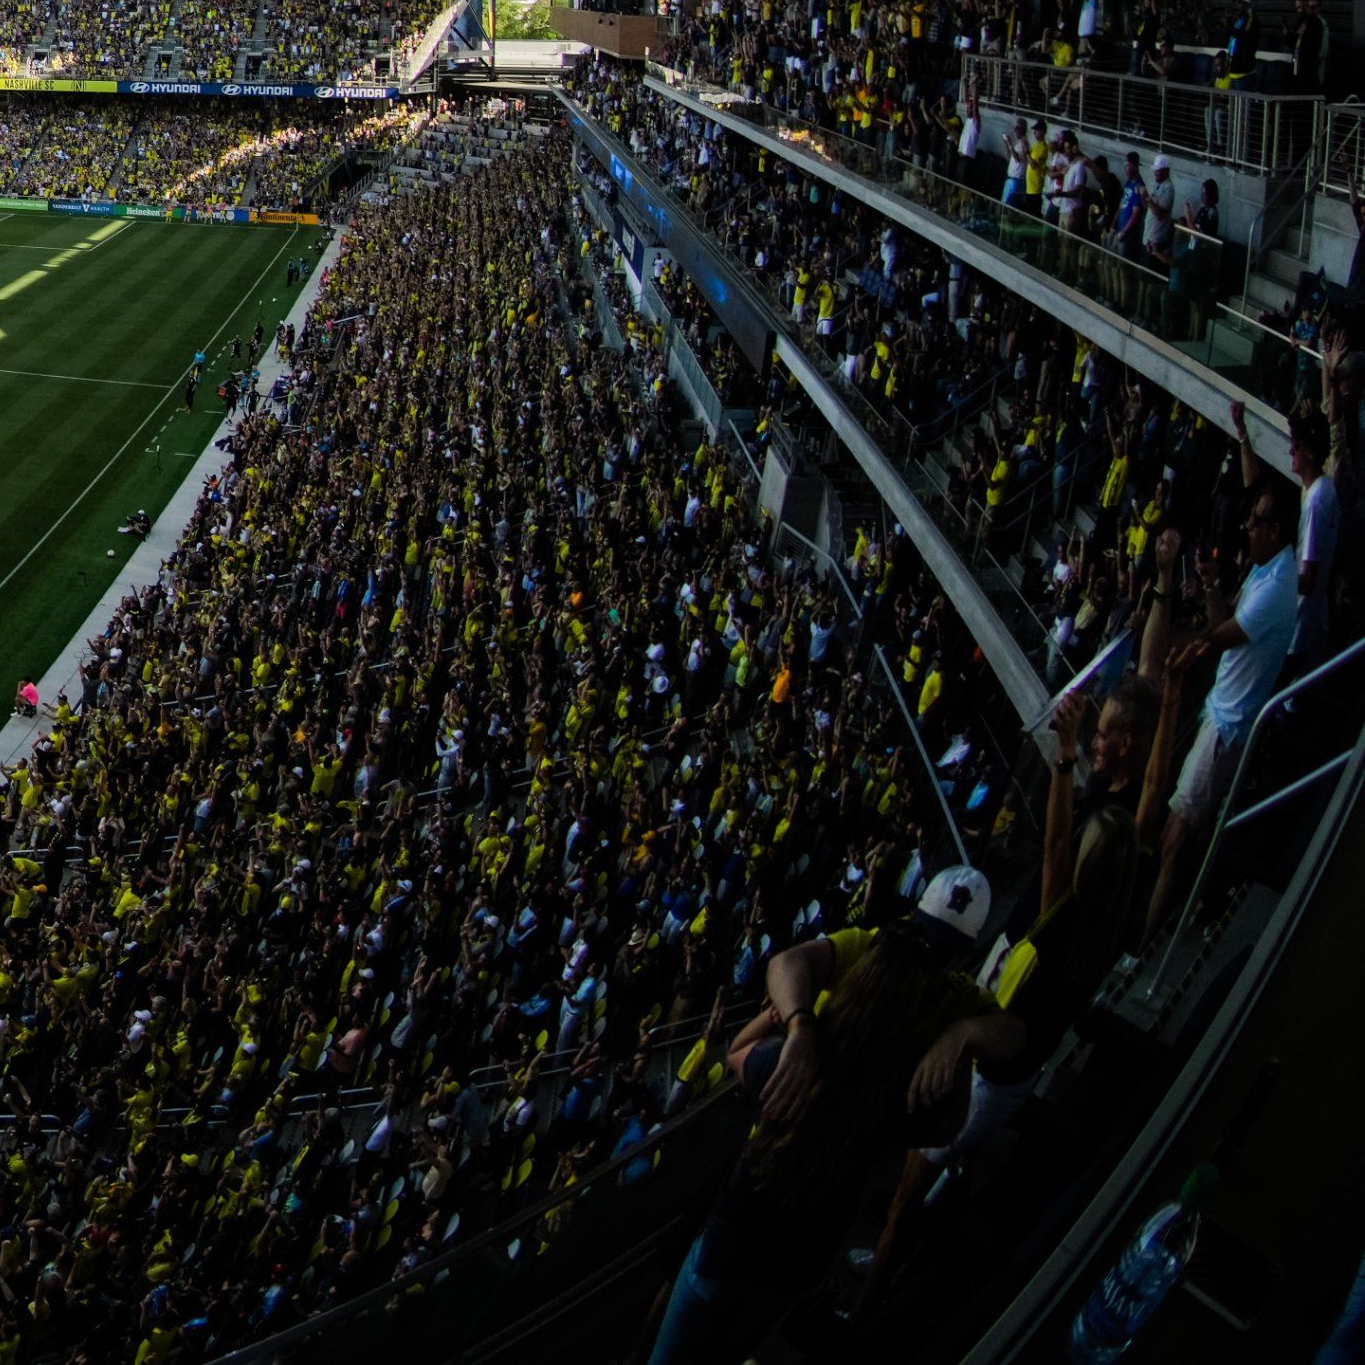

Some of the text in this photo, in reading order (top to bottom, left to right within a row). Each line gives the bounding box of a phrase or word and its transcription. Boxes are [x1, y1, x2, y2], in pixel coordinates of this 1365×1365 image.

[4, 79, 55, 90] NASHVILLE SC
[151, 84, 201, 94] HYUNDAI
[243, 85, 294, 96] HYUNDAI
[335, 87, 386, 98] HYUNDAI
[126, 207, 161, 217] Heineken
[261, 212, 299, 222] Continenta
